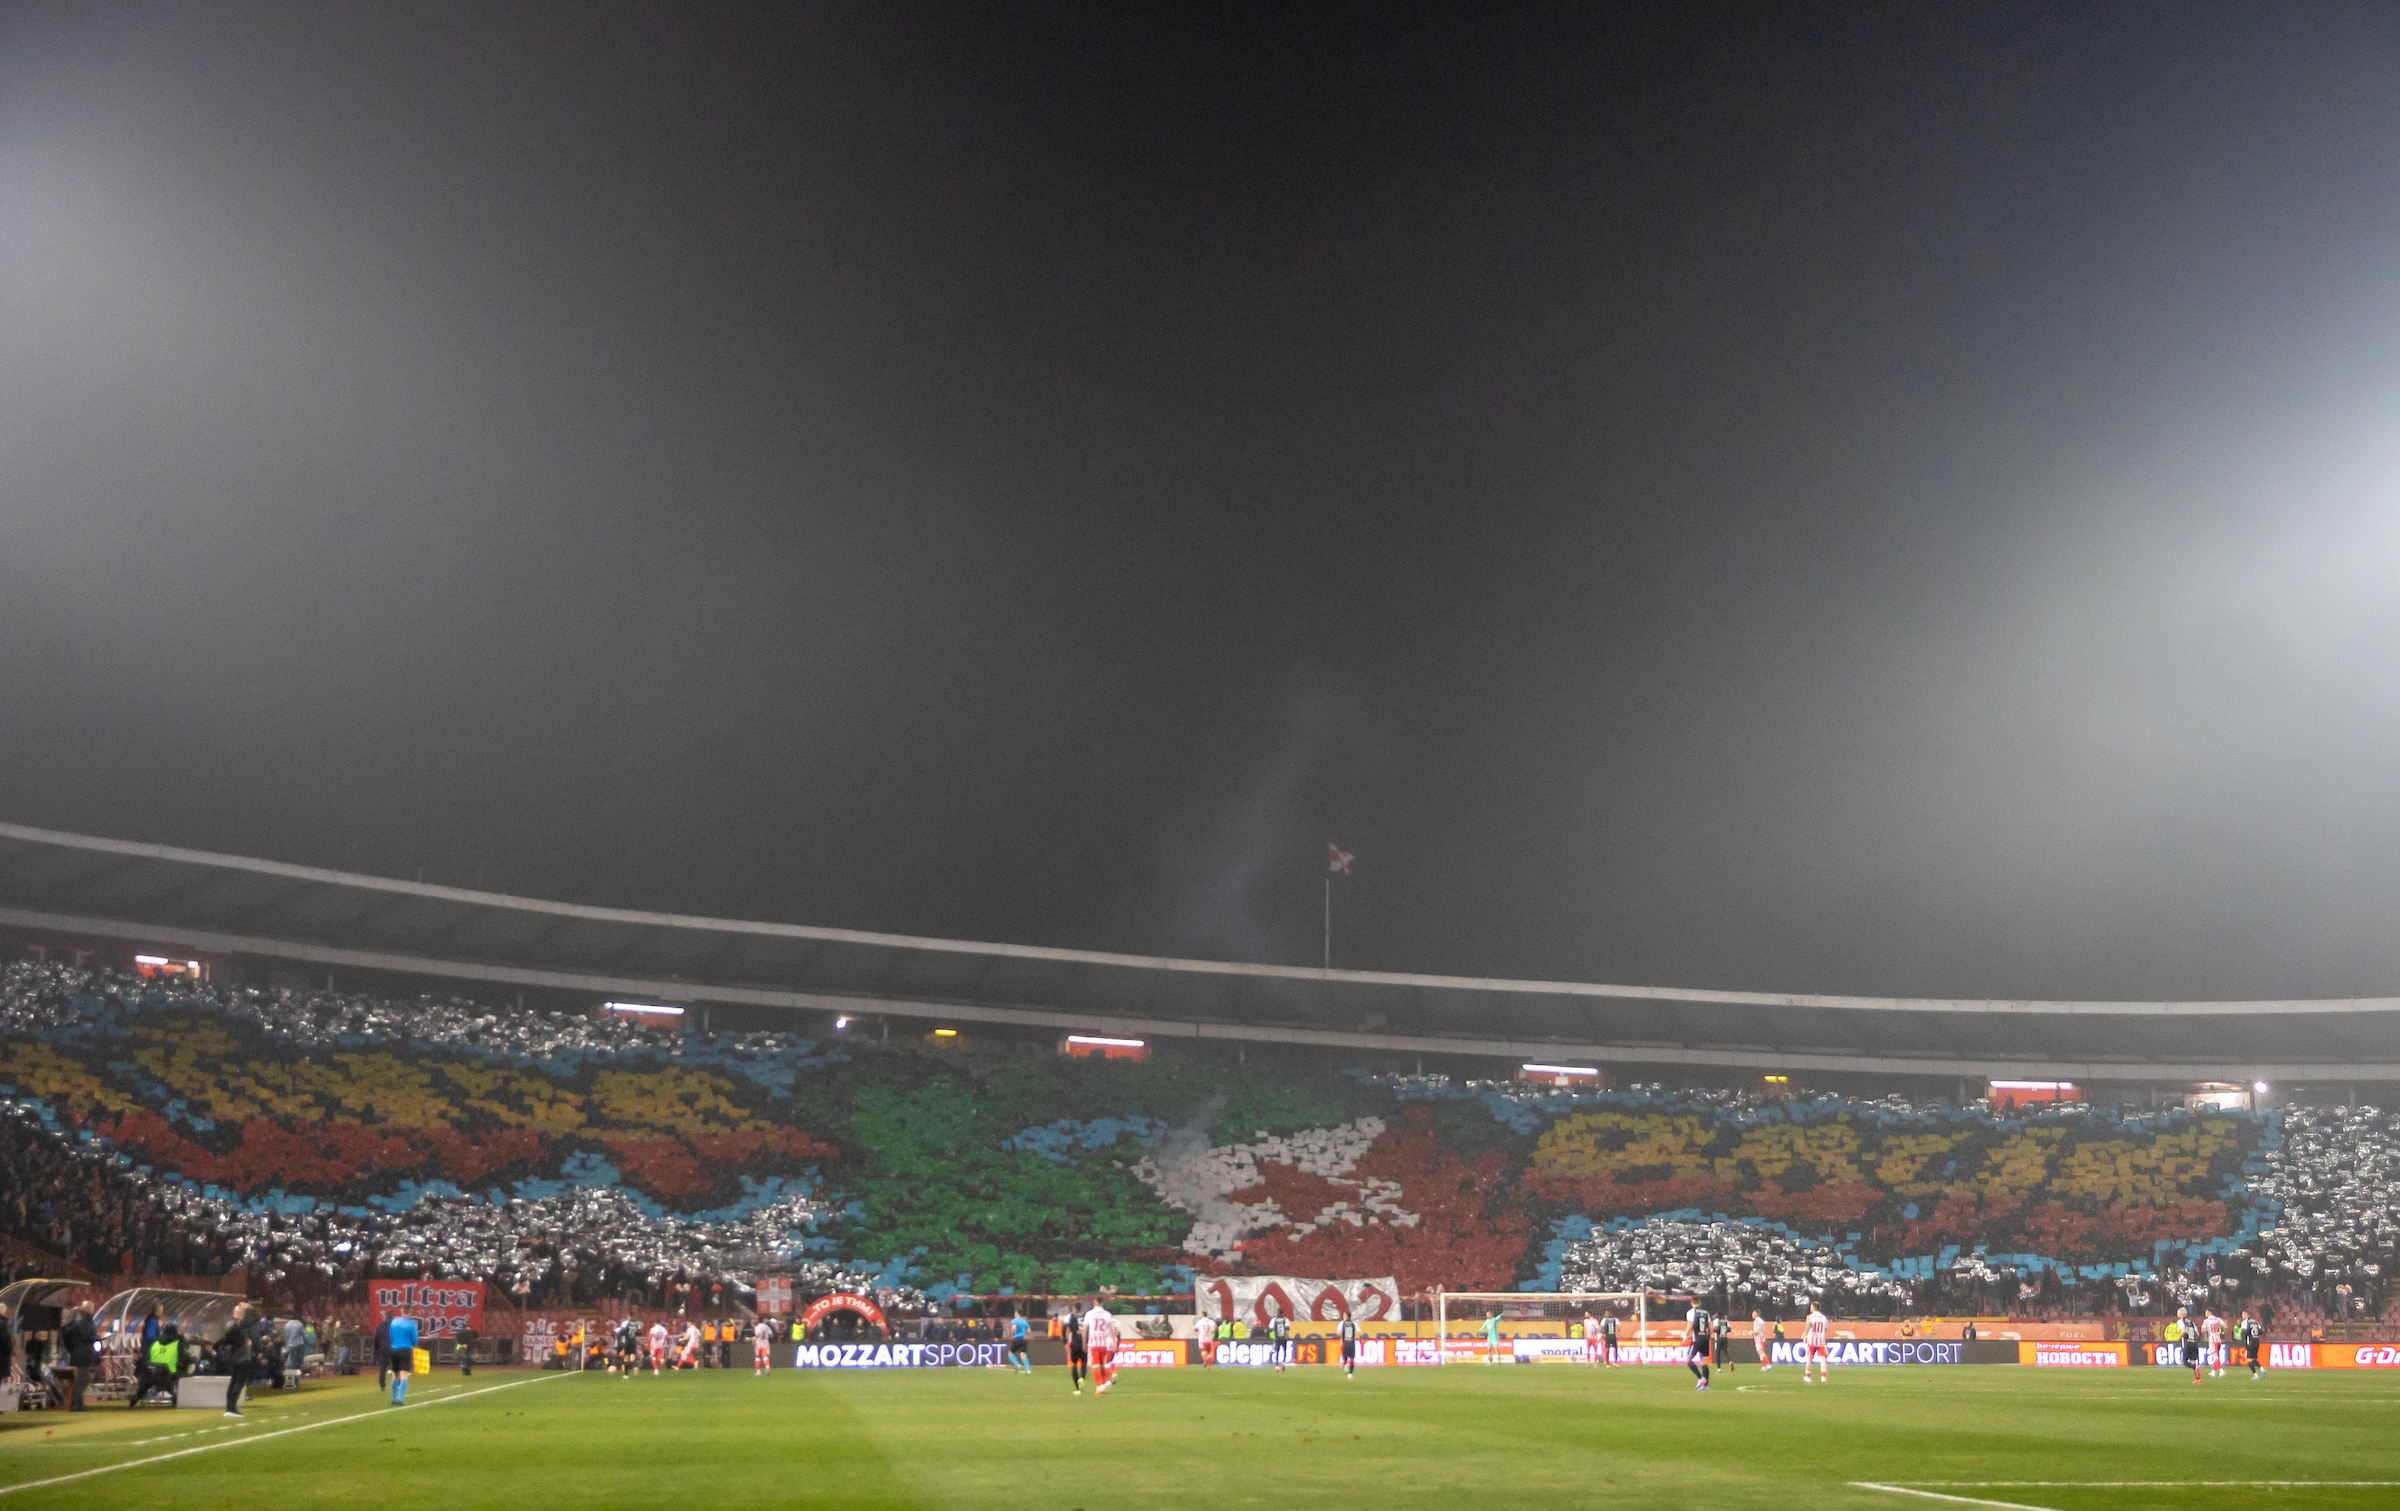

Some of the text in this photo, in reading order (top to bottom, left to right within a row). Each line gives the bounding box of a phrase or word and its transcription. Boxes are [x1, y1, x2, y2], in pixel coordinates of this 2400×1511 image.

[375, 1282, 478, 1308] ultra
[1338, 1340, 1384, 1363] LO!
[1608, 1346, 1701, 1362] INFORM
[1771, 1342, 1962, 1364] MOZARTSPORT
[2036, 1351, 2117, 1365] НОВОСТИ
[2269, 1344, 2312, 1367] ALO!
